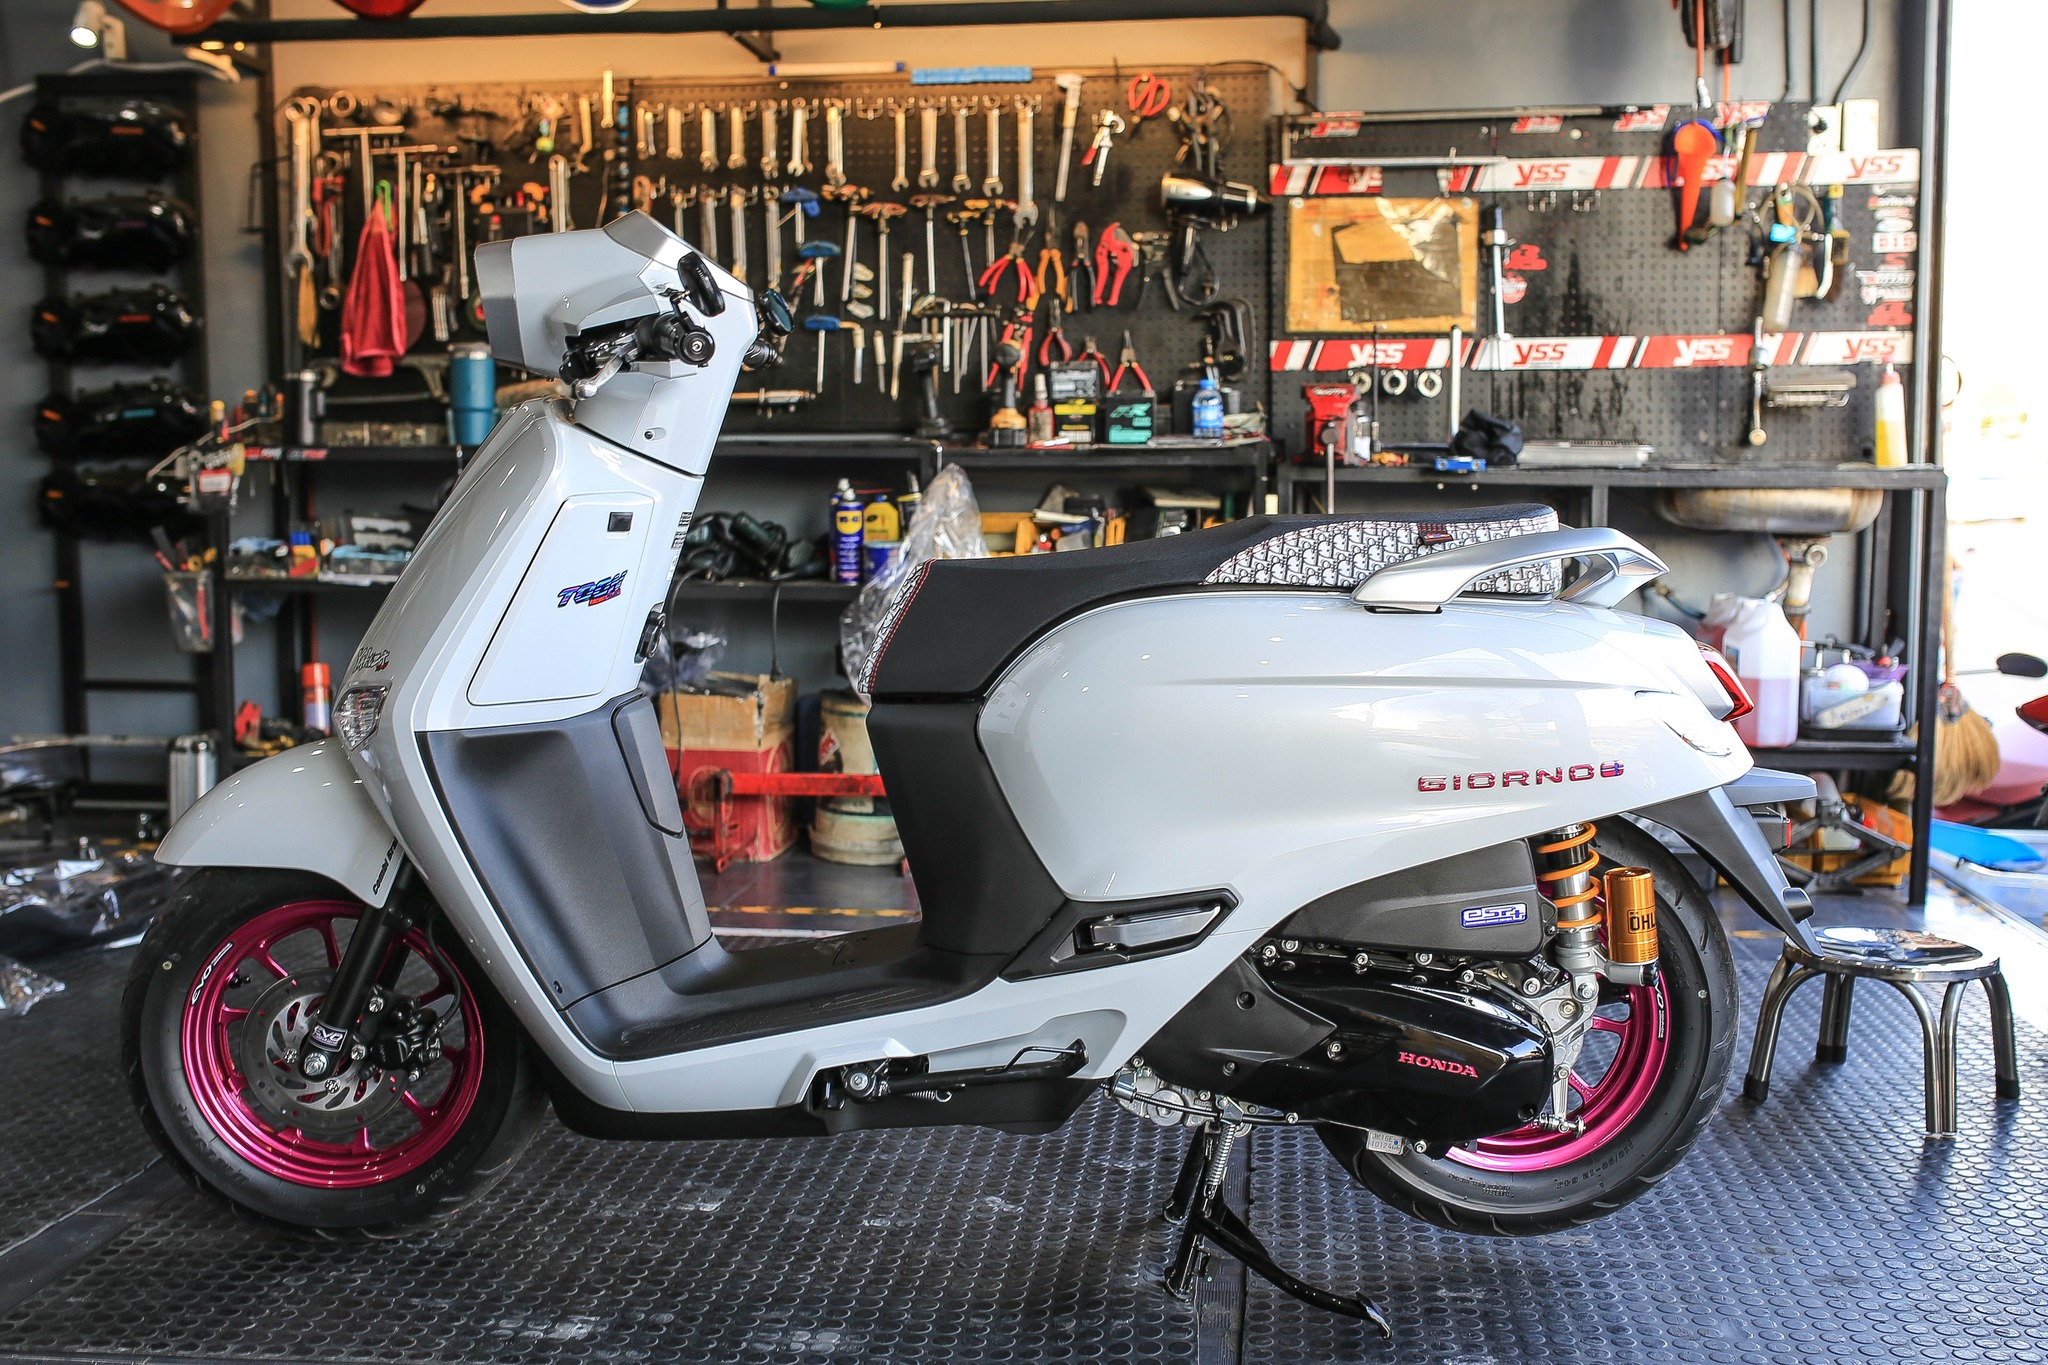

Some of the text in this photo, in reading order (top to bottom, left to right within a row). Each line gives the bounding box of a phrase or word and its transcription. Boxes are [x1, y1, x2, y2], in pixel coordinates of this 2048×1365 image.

[1514, 163, 1571, 187] YSS
[1701, 158, 1738, 179] SS
[1847, 156, 1904, 181] YSS
[1348, 342, 1406, 367] YSS
[1513, 343, 1568, 365] YSS
[1673, 338, 1734, 366] YSS
[1398, 1051, 1479, 1078] HONDA
